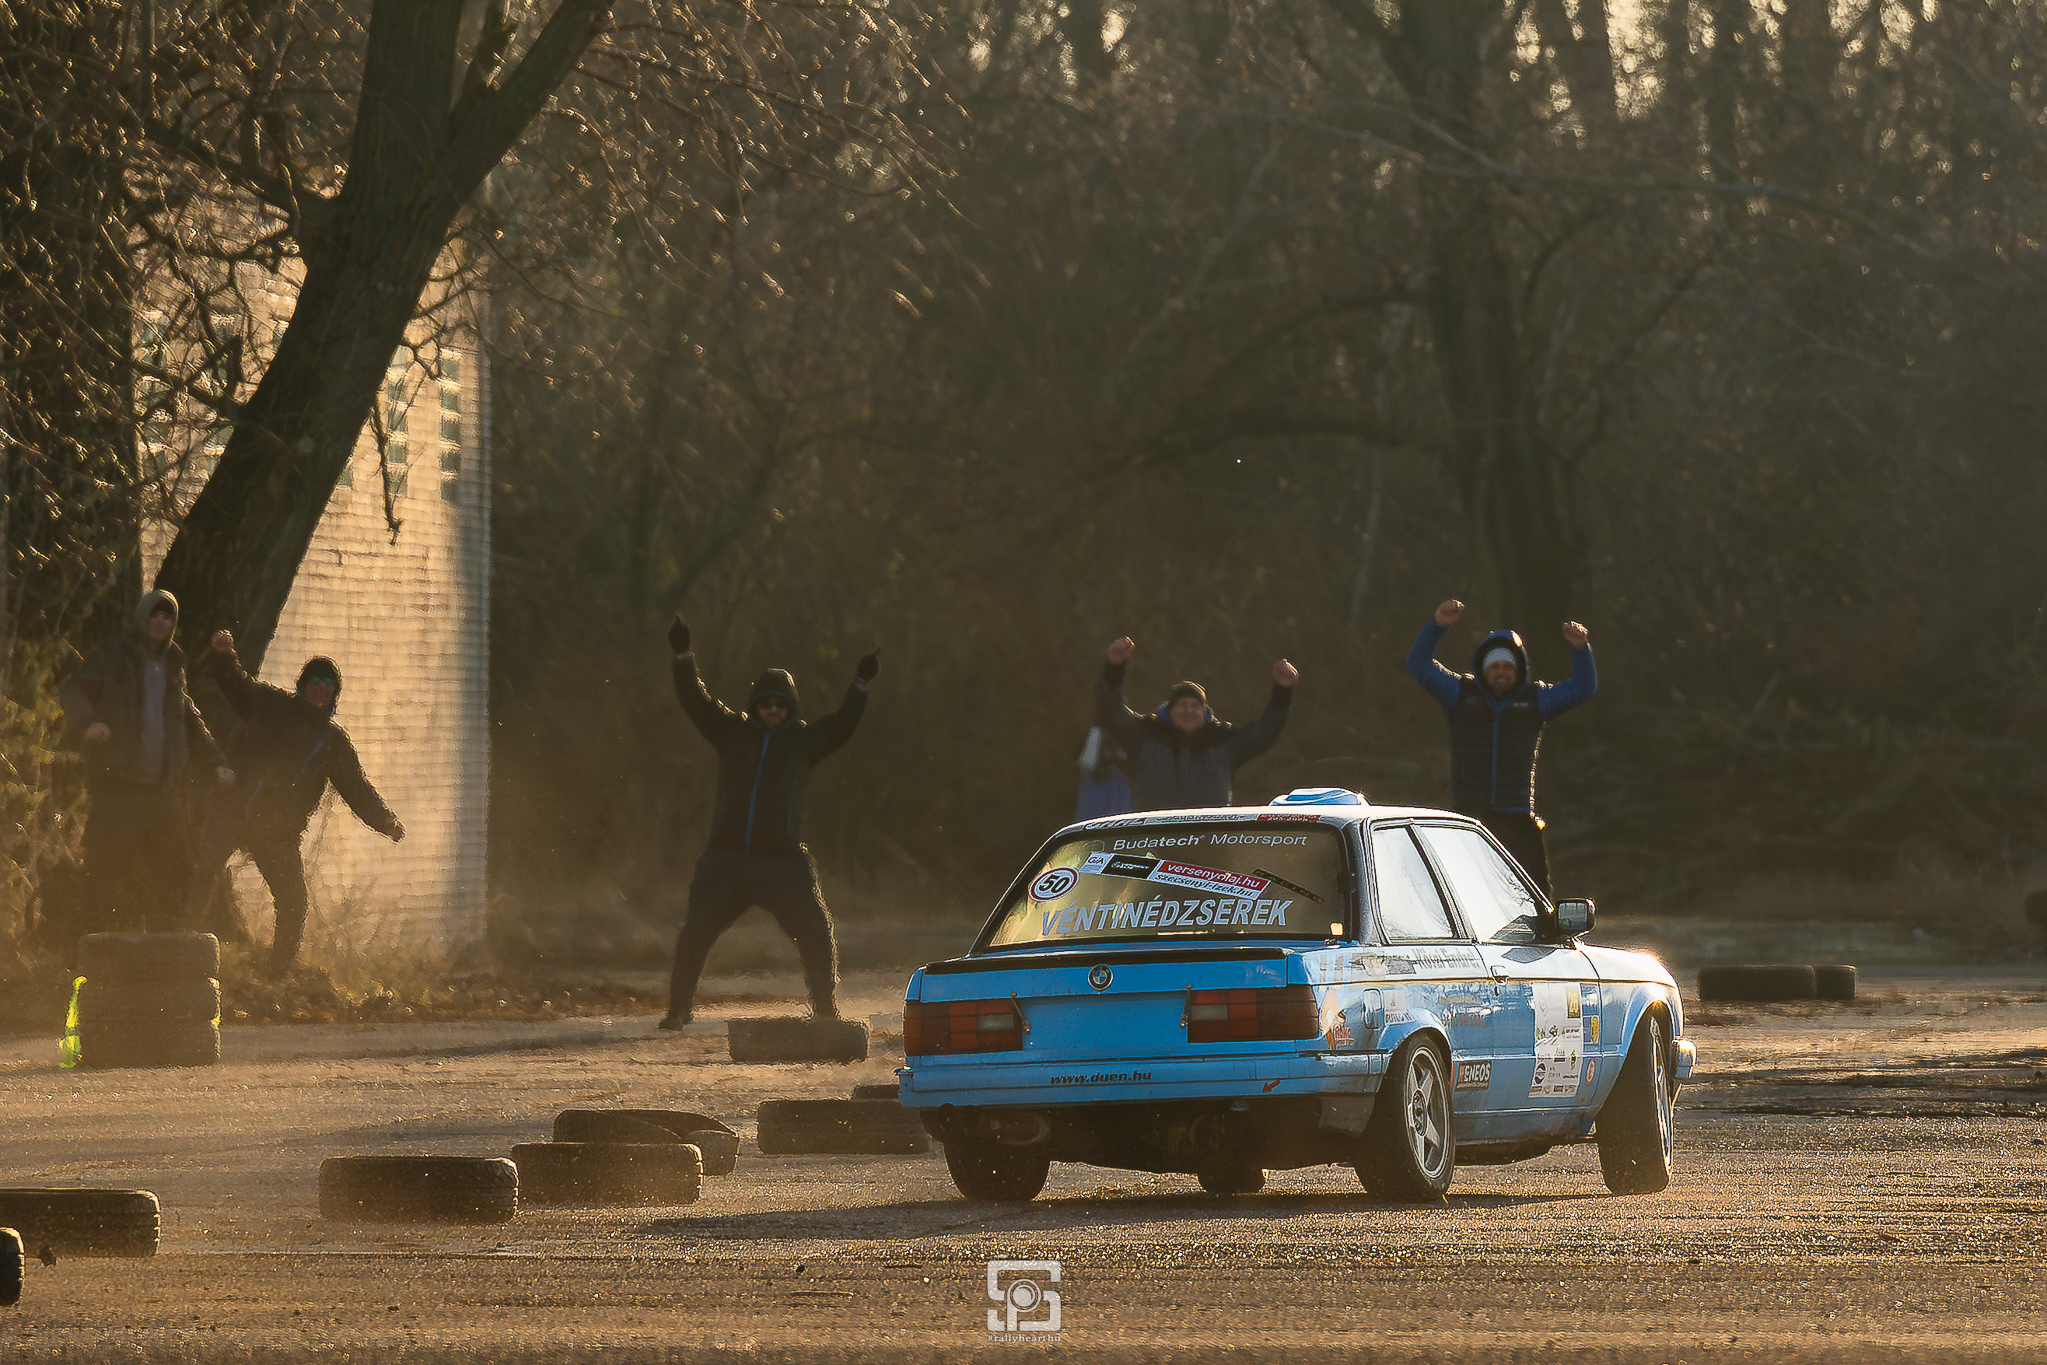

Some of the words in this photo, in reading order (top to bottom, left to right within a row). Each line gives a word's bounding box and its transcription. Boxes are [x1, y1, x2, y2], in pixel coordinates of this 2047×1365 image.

[1210, 833, 1308, 848] Motorsport
[1038, 874, 1070, 894] 50
[1167, 863, 1261, 888] versenyolaj.hu
[1050, 1070, 1152, 1084] www.duen.hu
[1463, 1062, 1491, 1082] ENEOS
